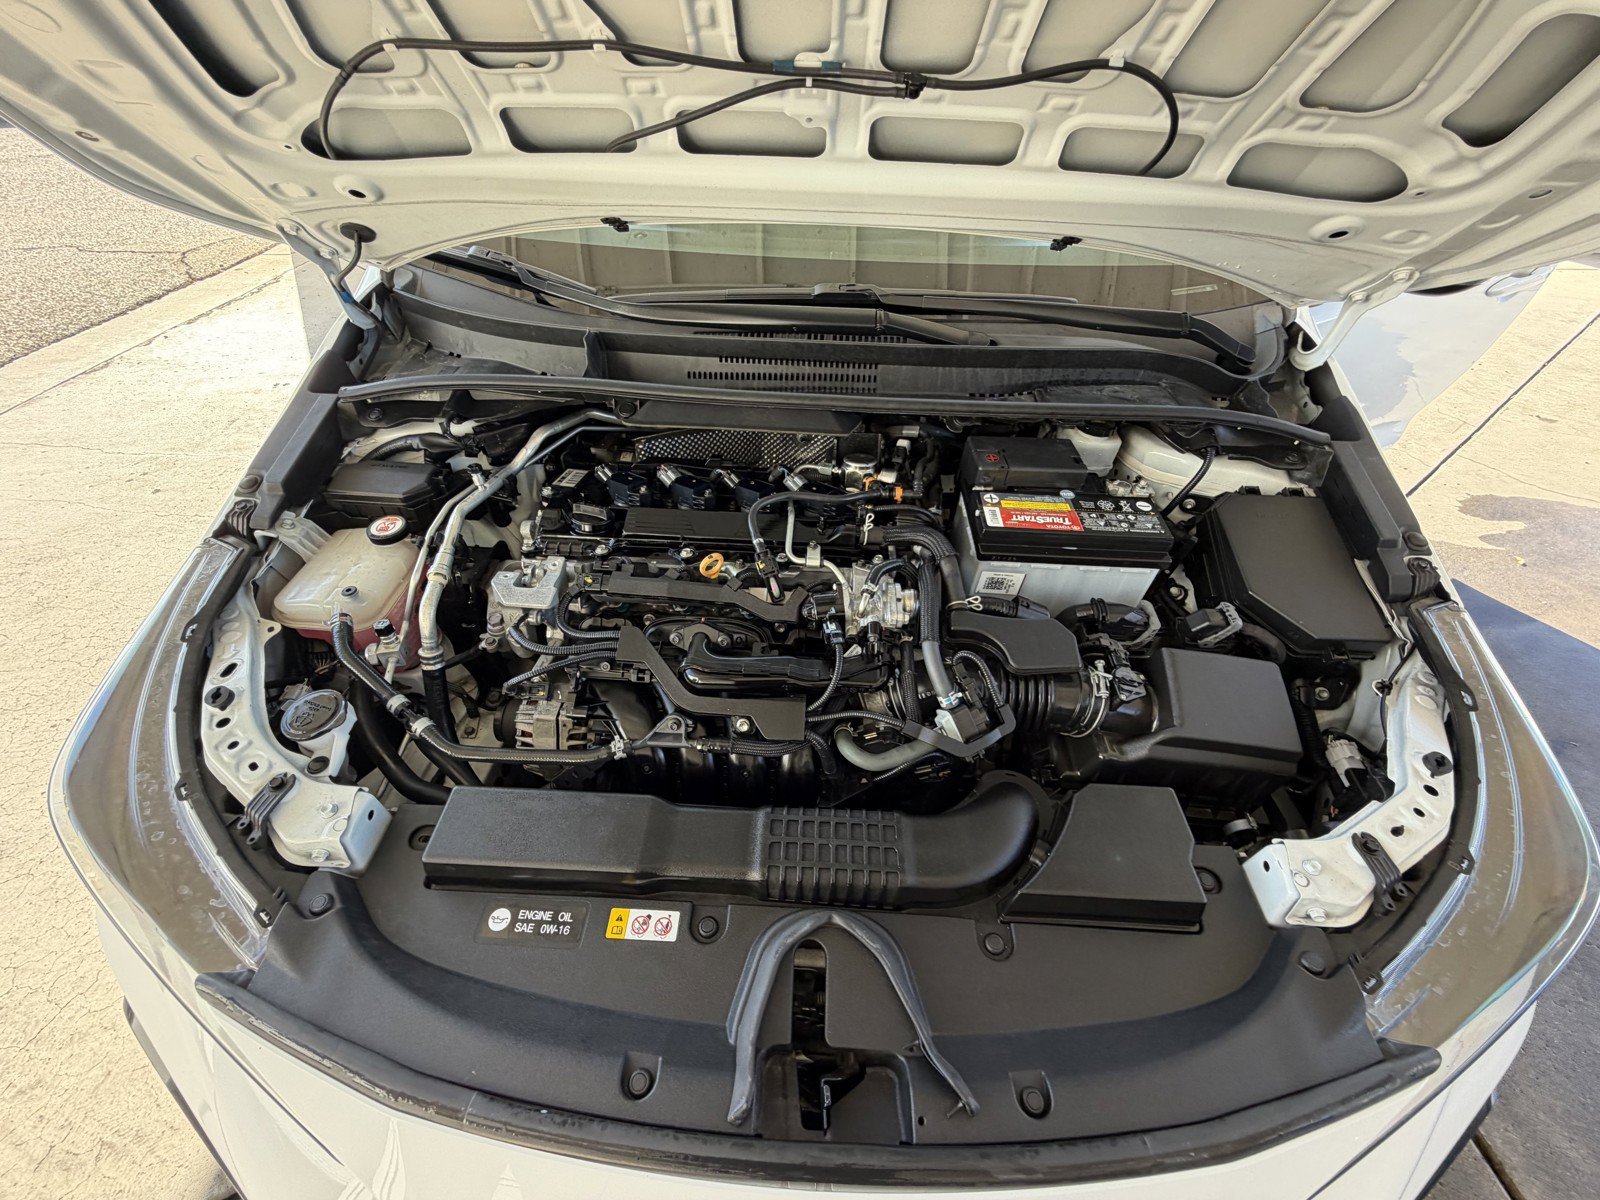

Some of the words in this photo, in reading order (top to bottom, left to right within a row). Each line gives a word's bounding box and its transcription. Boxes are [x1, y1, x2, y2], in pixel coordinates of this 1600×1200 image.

[518, 909, 554, 921] ENGINE
[558, 911, 574, 923] OIL
[514, 922, 536, 934] SAE
[540, 923, 571, 936] 0W-16
